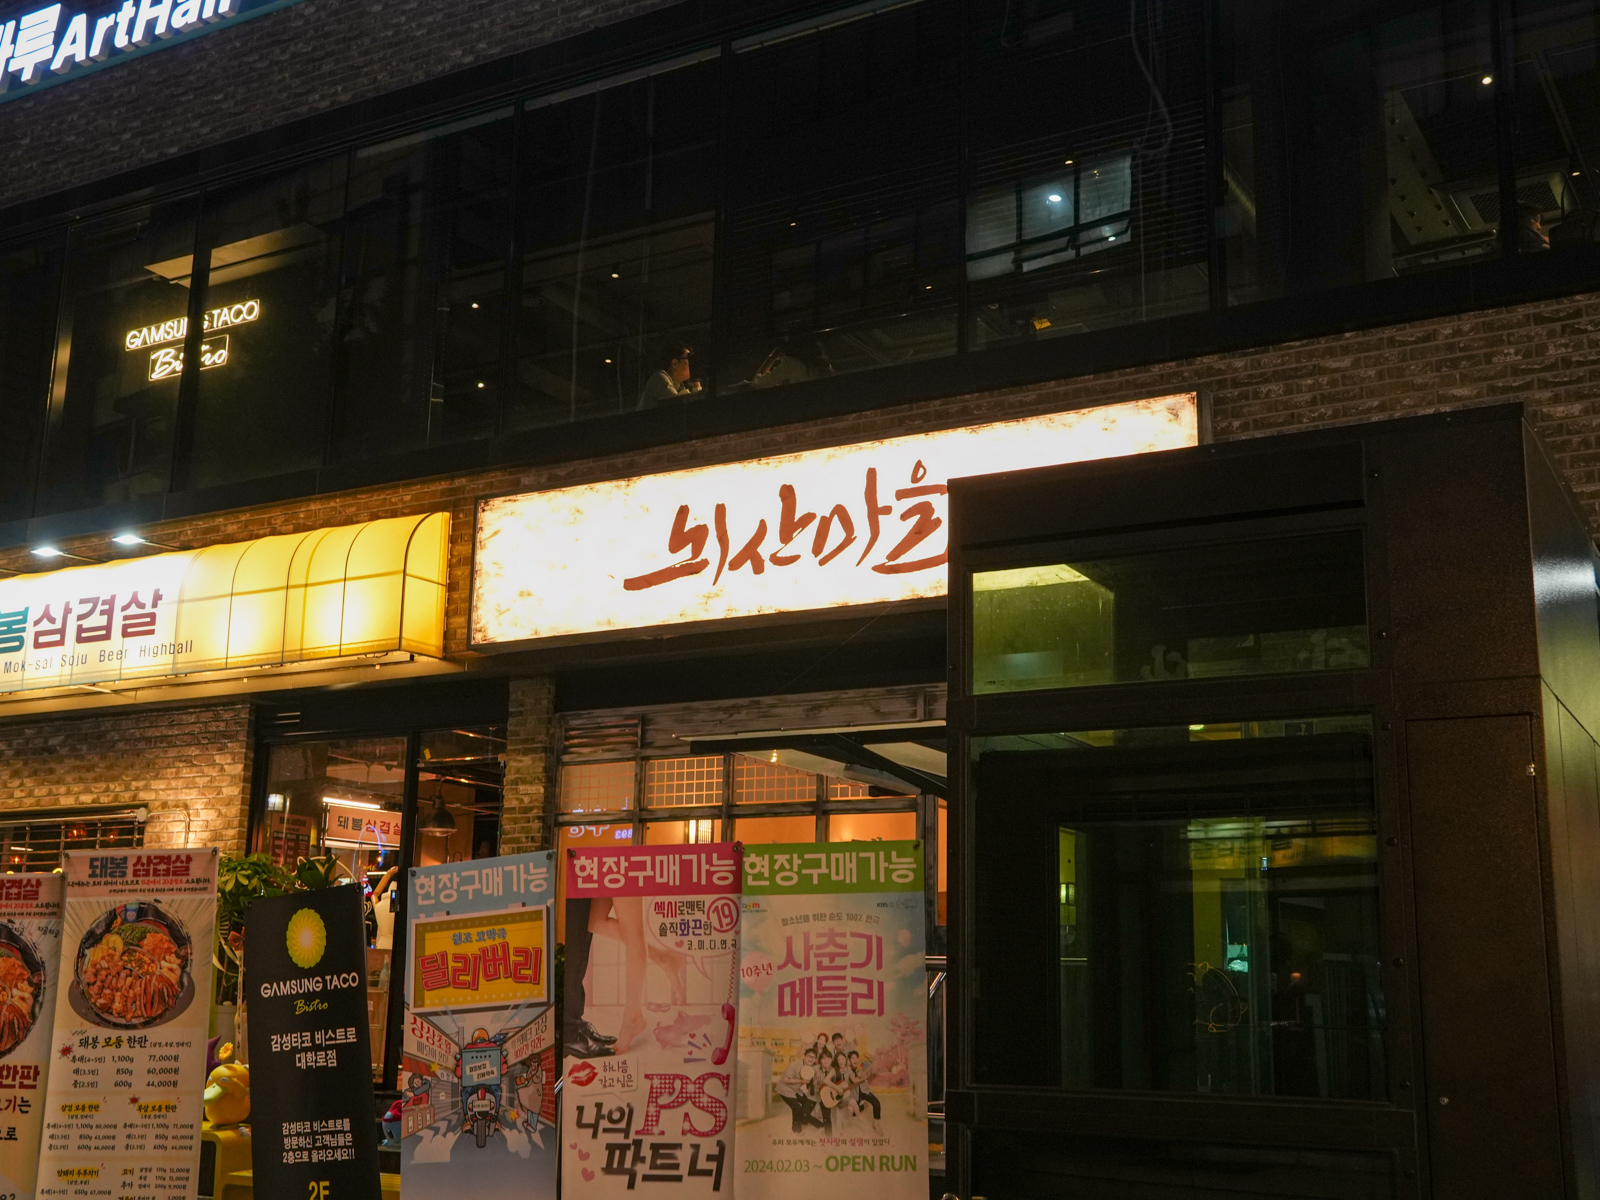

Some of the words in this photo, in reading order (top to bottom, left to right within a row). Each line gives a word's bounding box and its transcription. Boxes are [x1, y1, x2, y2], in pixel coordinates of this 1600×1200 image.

[212, 300, 258, 328] TACO
[150, 344, 226, 379] Biro
[4, 655, 52, 674] Mok-sal
[60, 653, 88, 667] Soju
[99, 648, 128, 662] Beer
[139, 640, 193, 658] Highball
[88, 857, 127, 878] 돼봉
[133, 854, 192, 877] 삼겹살
[574, 853, 736, 888] 현장구매가능
[743, 851, 917, 886] 현장구매가능
[415, 862, 549, 906] 현장구매가능
[654, 900, 706, 918] 섹시로맨틱
[712, 902, 734, 929] 19
[812, 912, 827, 922] 위한
[829, 912, 844, 921] 순도
[846, 913, 863, 922] 100%
[659, 918, 713, 937] 솔직화끈한
[777, 927, 884, 972] 사춘기
[418, 941, 542, 991] 딜리버리
[740, 962, 773, 979] 10주년
[261, 976, 323, 998] GAMSUNG
[325, 972, 359, 990] TACO
[777, 975, 885, 1018] 메들리
[294, 999, 329, 1015] Bistro
[534, 1013, 547, 1036] 고장
[78, 1035, 100, 1050] 돼봉
[101, 1035, 124, 1049] 모둠
[126, 1034, 148, 1049] 한판
[271, 1031, 313, 1052] 감성타코
[315, 1027, 357, 1047] 비스트로
[410, 1015, 452, 1056] 상상초월
[111, 1055, 134, 1063] 1,100g
[148, 1054, 179, 1063] 77,000원
[295, 1049, 337, 1069] 대학로점
[602, 1059, 628, 1074] 하나쯤
[116, 1068, 133, 1076] 850g
[147, 1067, 179, 1075] 60,000원
[598, 1076, 615, 1089] 갖고
[616, 1073, 634, 1088] 싶은
[114, 1080, 132, 1088] 600g
[146, 1080, 178, 1088] 44,000원
[576, 1102, 634, 1139] 나의
[635, 1072, 730, 1137] PS
[282, 1121, 311, 1135] 감성타코
[313, 1118, 350, 1133] 비스트로를
[284, 1135, 313, 1149] 방문하신
[315, 1133, 353, 1147] 고객님들은
[771, 1138, 784, 1146] 우리
[818, 1137, 847, 1147] 첫사랑의
[849, 1137, 870, 1147] 설렘이
[282, 1150, 309, 1164] 2층으로
[311, 1148, 355, 1162] 올라오세요!!
[744, 1159, 810, 1173] 2024.02.03
[825, 1155, 875, 1172] OPEN
[879, 1154, 917, 1172] RUN
[309, 1181, 330, 1200] 2F
